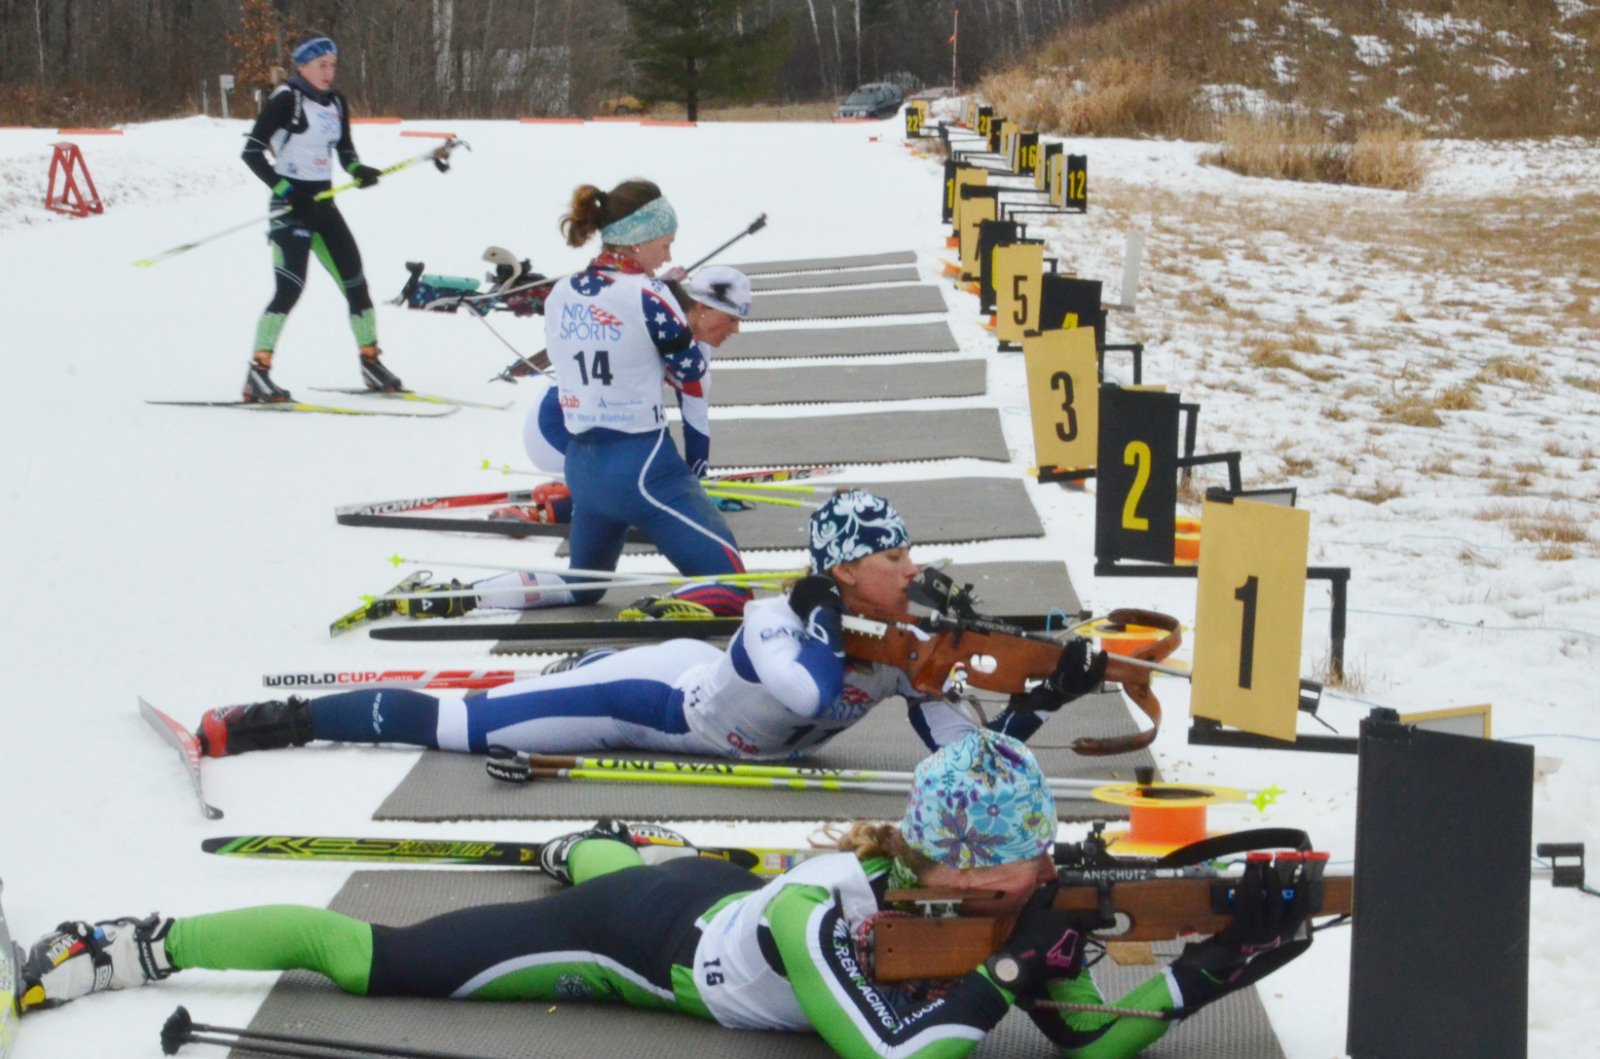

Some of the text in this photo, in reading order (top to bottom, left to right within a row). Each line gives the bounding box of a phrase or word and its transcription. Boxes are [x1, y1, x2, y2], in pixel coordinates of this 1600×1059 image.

[907, 115, 919, 133] 22
[1021, 144, 1037, 168] 16
[1069, 169, 1086, 199] 12
[562, 303, 596, 321] NRA
[1012, 274, 1028, 326] 5
[559, 321, 622, 342] SPORTS
[573, 350, 614, 386] 14
[1050, 371, 1078, 442] 3
[1121, 440, 1152, 532] 2
[360, 497, 438, 516] ATOMIC
[1234, 575, 1259, 691] 1
